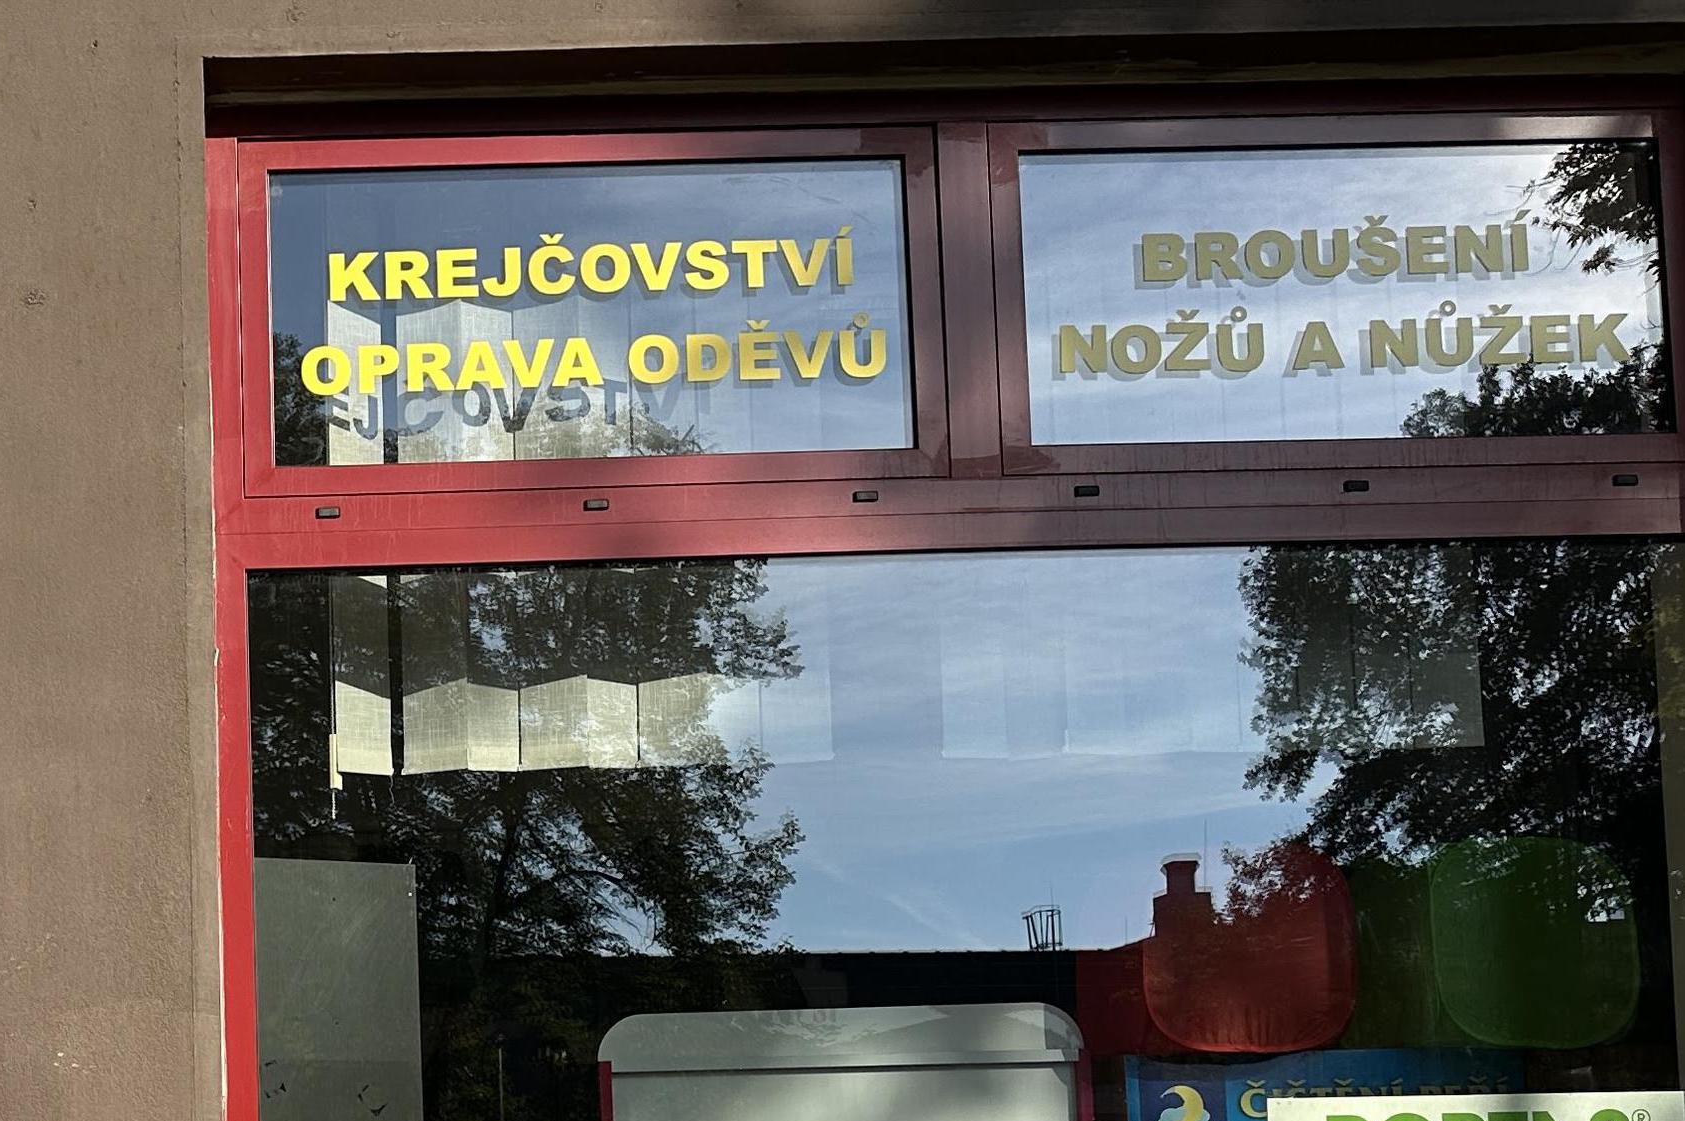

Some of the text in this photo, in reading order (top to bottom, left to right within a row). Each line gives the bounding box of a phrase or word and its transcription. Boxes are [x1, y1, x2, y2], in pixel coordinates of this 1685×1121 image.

[328, 225, 855, 302] KREJČOVSTVÍ
[1139, 209, 1531, 282] BROUŠENÍ
[300, 311, 888, 396] OPRAVA ODĚVŮ
[1059, 300, 1633, 373] NOŽŮ A NŮŽEK
